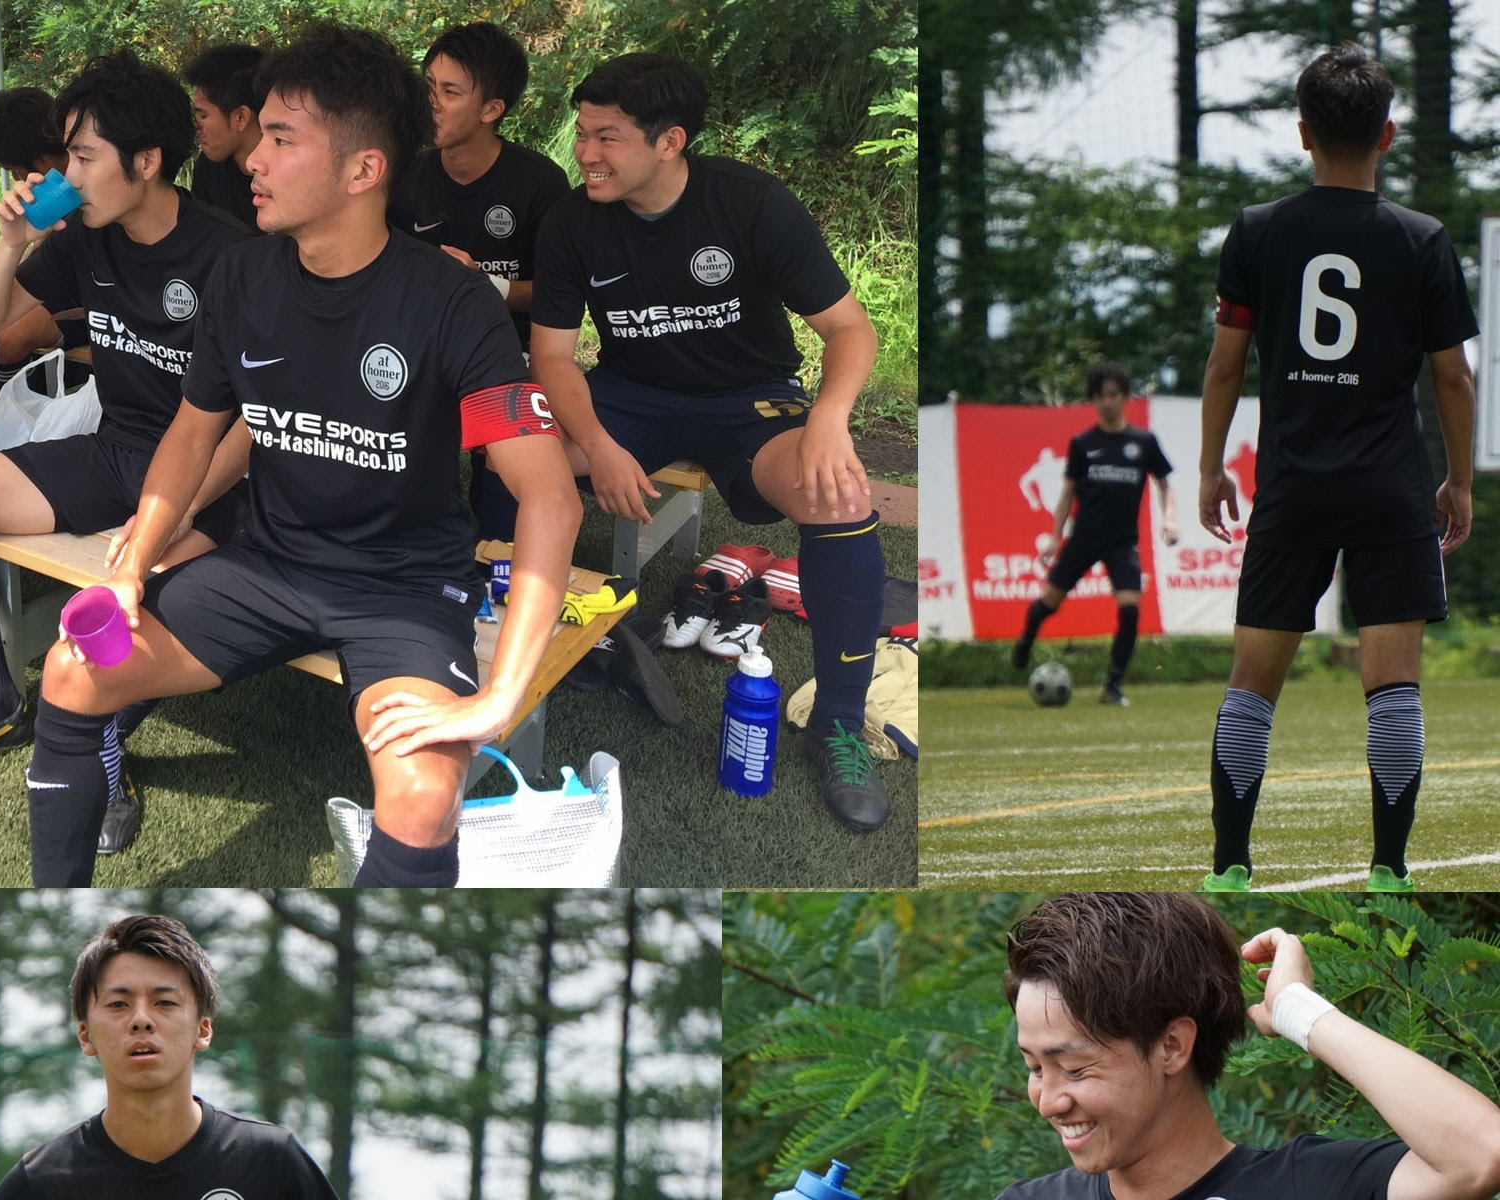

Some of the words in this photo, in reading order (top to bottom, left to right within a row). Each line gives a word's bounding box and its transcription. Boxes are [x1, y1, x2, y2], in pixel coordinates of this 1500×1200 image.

[474, 259, 520, 272] PORTS
[706, 253, 717, 263] at
[696, 262, 730, 272] homer
[166, 293, 195, 307] homer
[173, 287, 184, 297] at
[606, 305, 671, 325] EVE
[672, 297, 741, 319] SPORTS
[1298, 253, 1362, 362] 6
[612, 310, 742, 339] eve-kashiwa.co.jp
[378, 355, 390, 367] at
[367, 363, 401, 381] homer
[1287, 370, 1298, 381] at
[1301, 370, 1335, 383] homer
[1336, 372, 1360, 386] 2016
[375, 379, 390, 391] 2016
[241, 402, 322, 436] EVE
[325, 420, 408, 450] SPORTS
[726, 717, 748, 763] VITAL
[743, 724, 770, 783] amino
